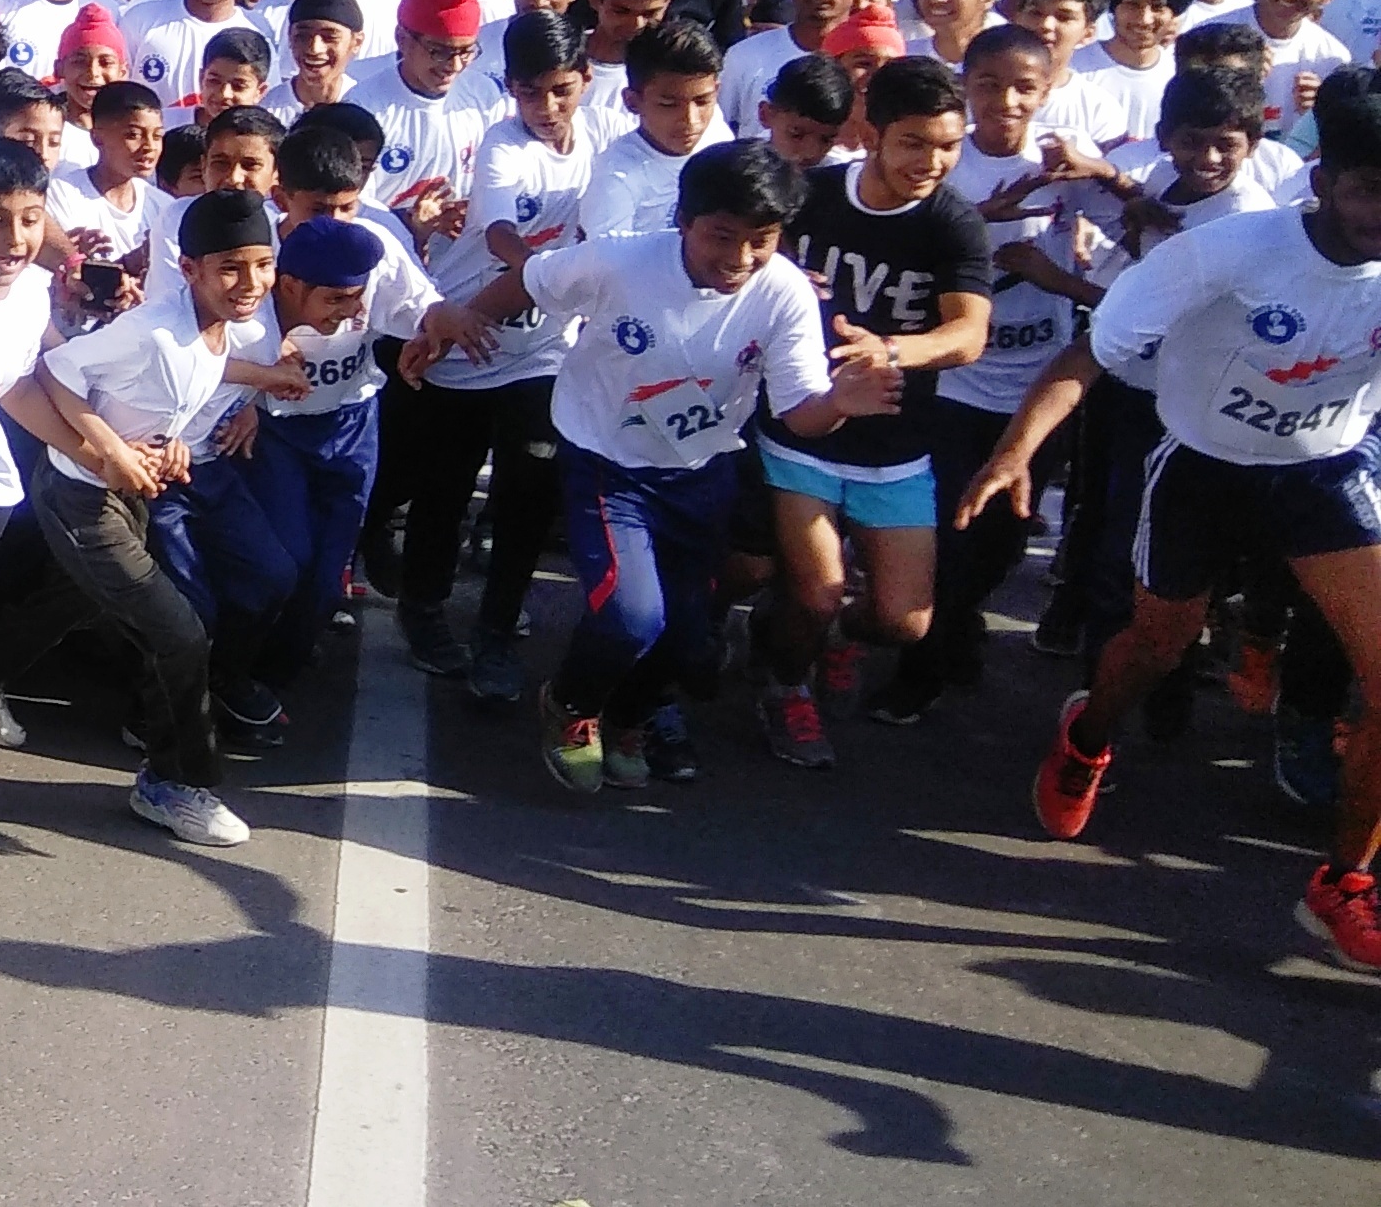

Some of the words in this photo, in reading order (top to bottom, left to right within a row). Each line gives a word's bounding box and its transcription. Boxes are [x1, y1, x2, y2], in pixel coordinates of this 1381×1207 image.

[986, 317, 1054, 349] 603
[666, 404, 725, 441] 22
[1219, 386, 1350, 437] 22847
